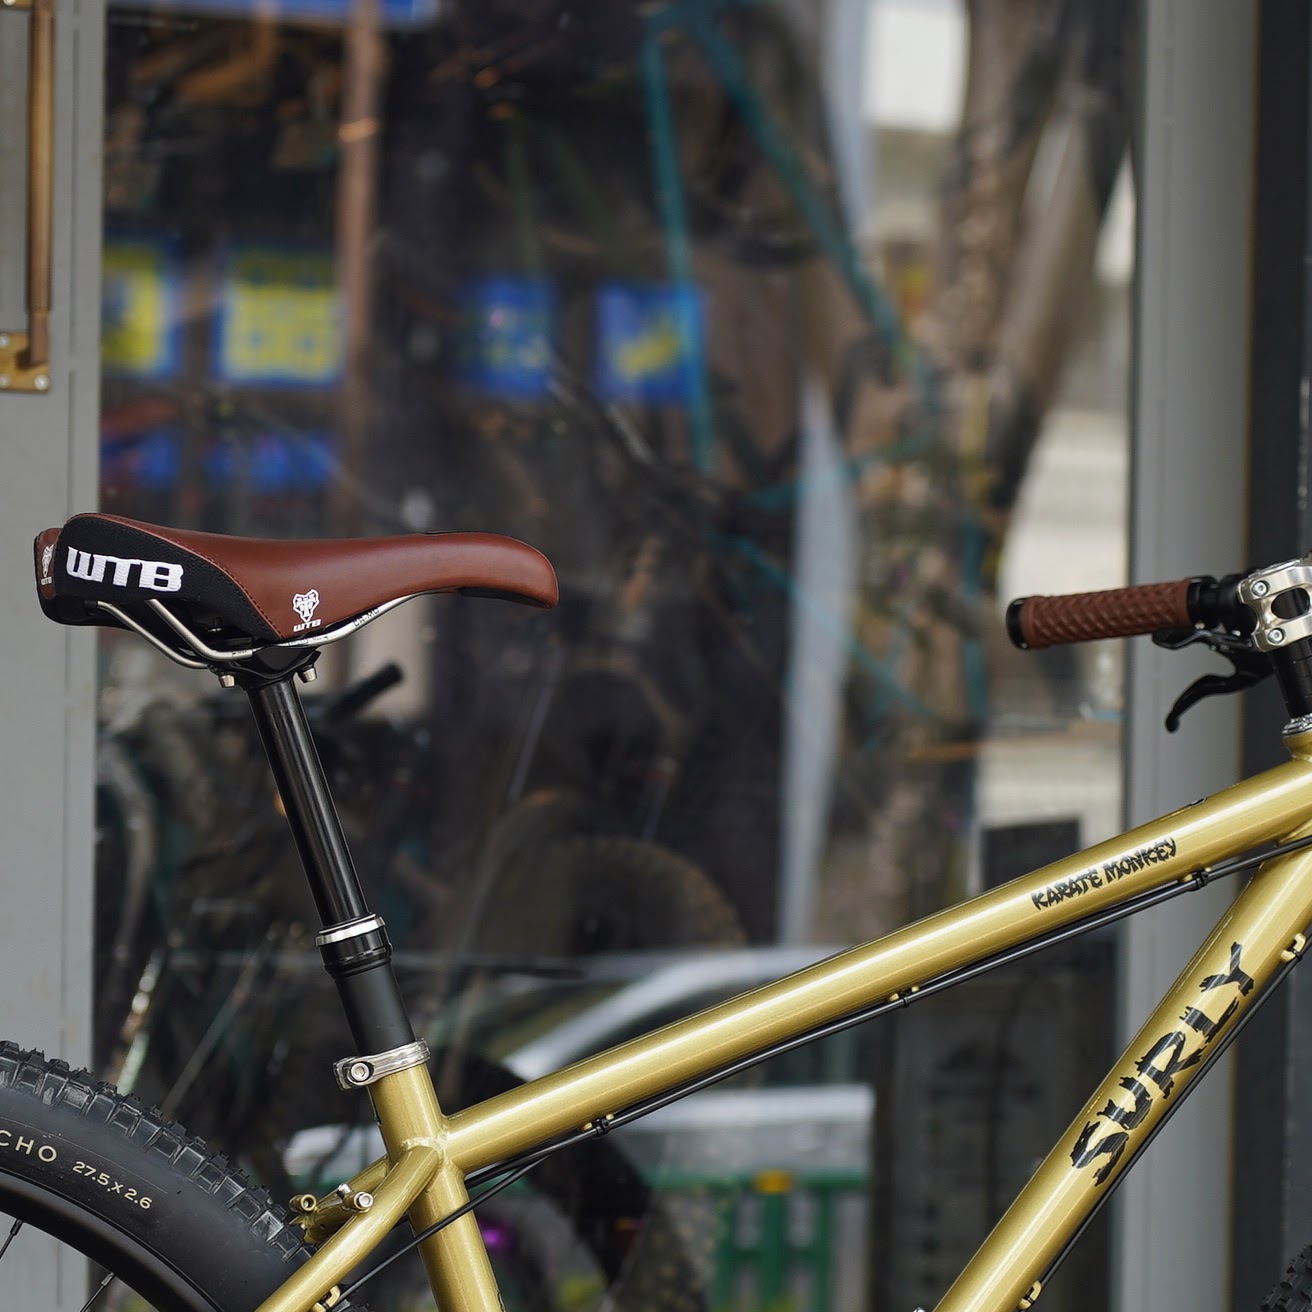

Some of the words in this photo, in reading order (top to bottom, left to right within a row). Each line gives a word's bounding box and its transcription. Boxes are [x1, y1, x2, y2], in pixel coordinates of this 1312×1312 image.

[66, 546, 184, 592] WTB
[293, 619, 322, 632] WTB
[1031, 869, 1103, 910] KARATE
[1103, 836, 1177, 884] MONKEY
[1069, 941, 1255, 1187] SURLY
